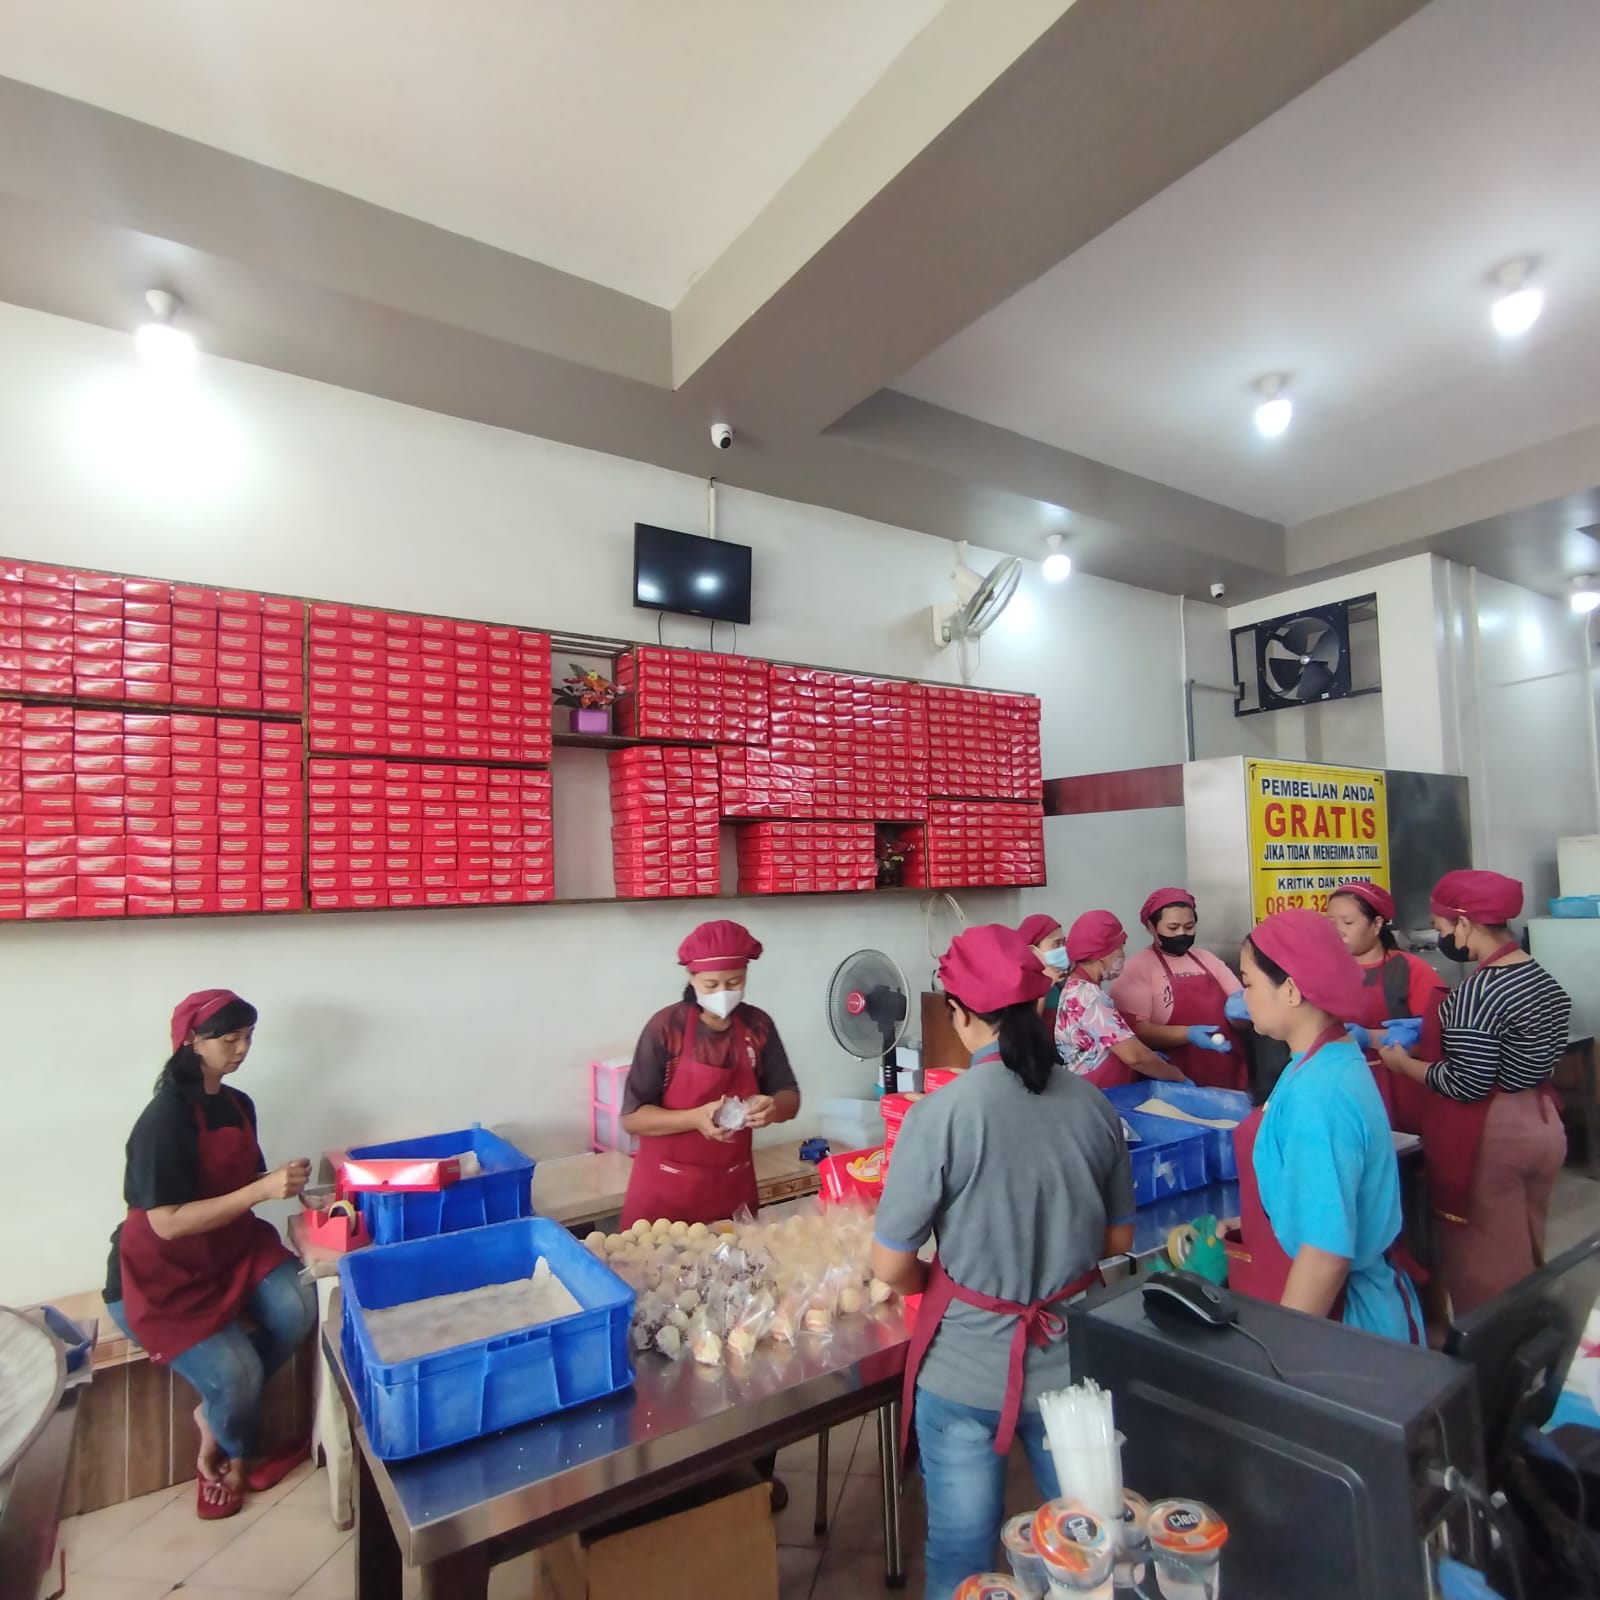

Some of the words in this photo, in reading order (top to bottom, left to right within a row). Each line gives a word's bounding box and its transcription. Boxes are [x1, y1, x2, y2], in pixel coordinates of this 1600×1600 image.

[1261, 778, 1338, 800] PEMBELIAN
[1342, 785, 1376, 802] ANDA
[1264, 802, 1376, 839] GRATIS
[1264, 844, 1285, 860] JIKA
[1286, 844, 1311, 860] TIDAK
[1313, 845, 1355, 860] MENERIMA
[1356, 845, 1379, 860] STRUK
[1277, 877, 1314, 890] KRITIK
[1318, 876, 1336, 889] DAN
[1069, 1517, 1091, 1543] Cleo
[1168, 1512, 1199, 1528] Cleo
